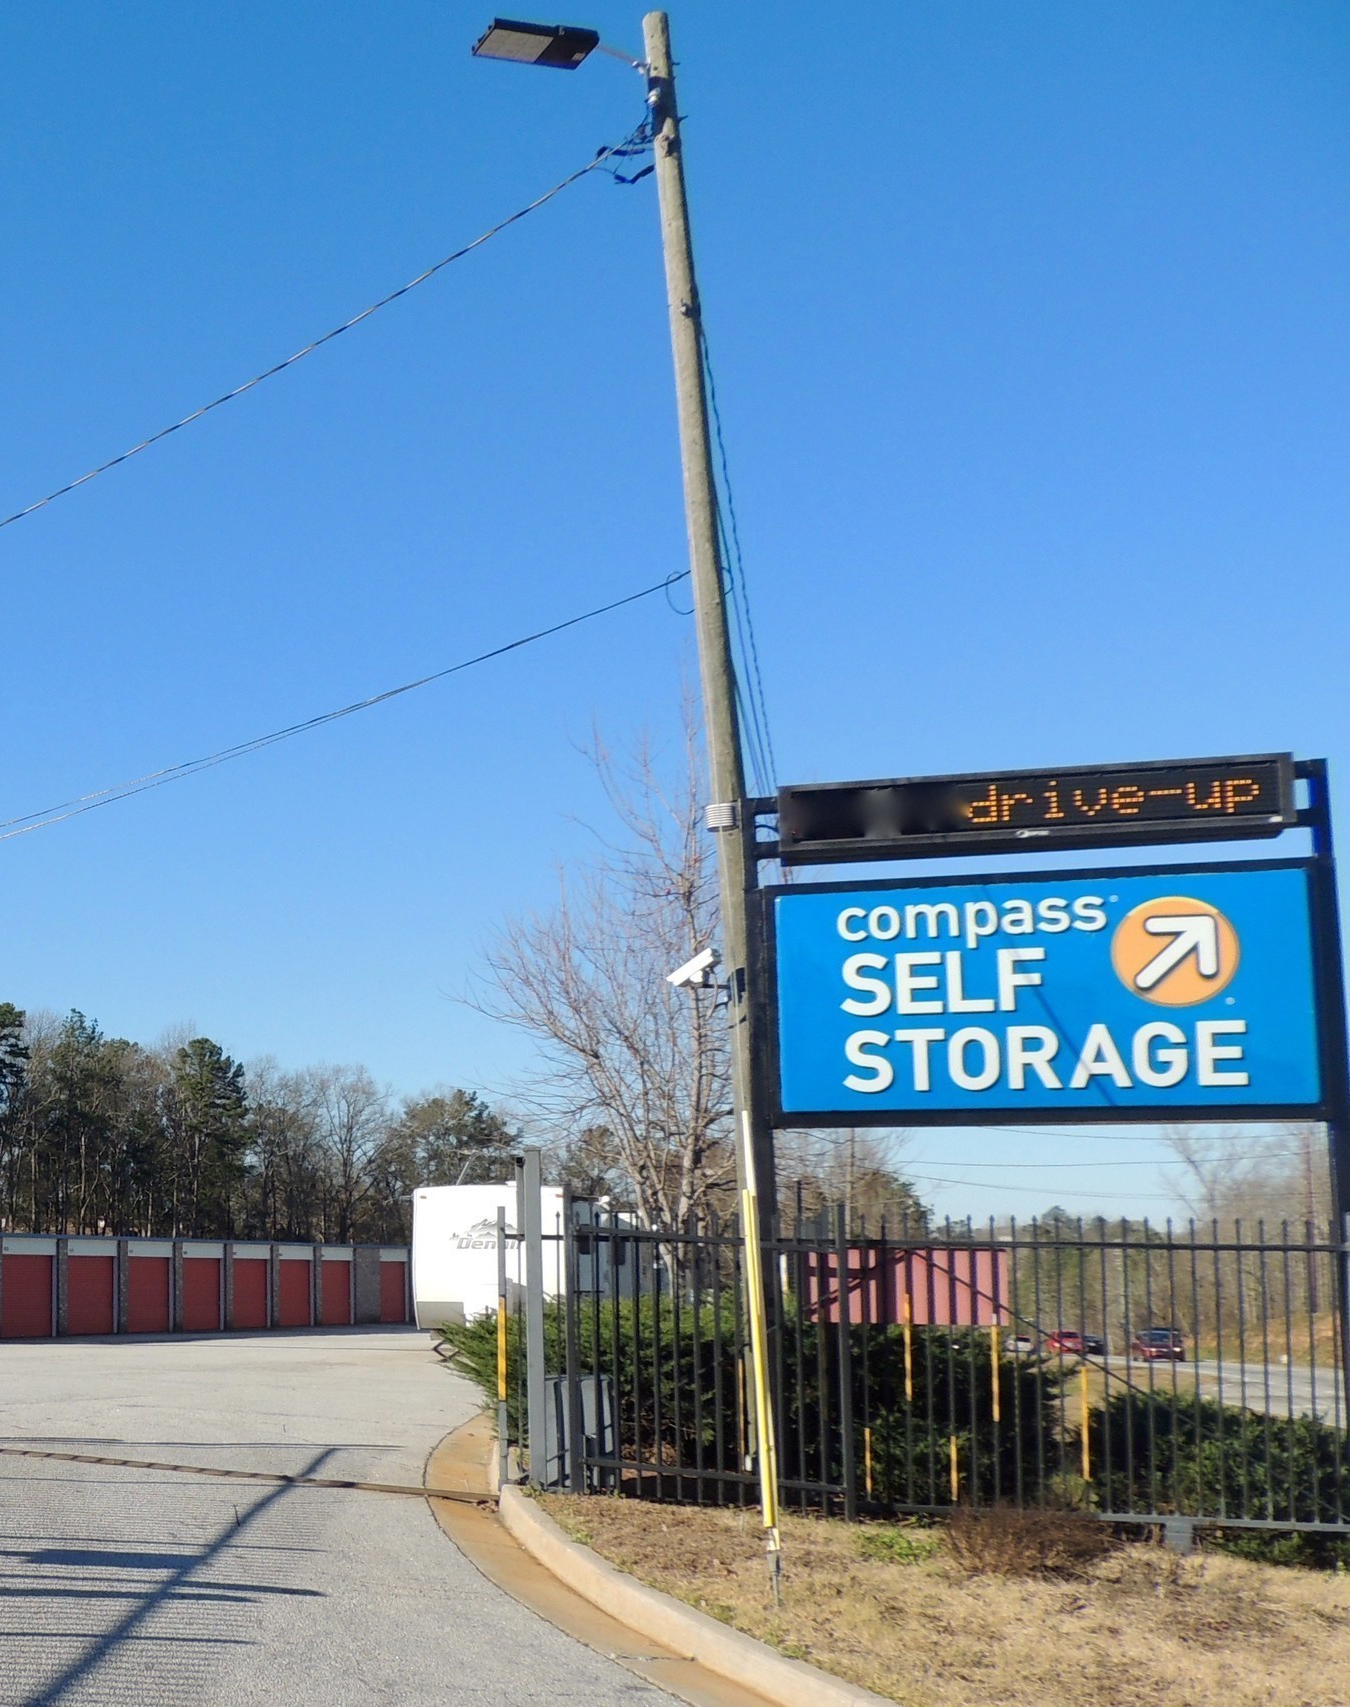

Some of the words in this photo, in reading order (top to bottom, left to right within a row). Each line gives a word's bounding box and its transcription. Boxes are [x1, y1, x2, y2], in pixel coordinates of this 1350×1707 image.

[968, 779, 1260, 824] drive-up
[837, 895, 1107, 949] compass
[840, 947, 1045, 1016] SELF
[842, 1020, 1249, 1093] STORAGE
